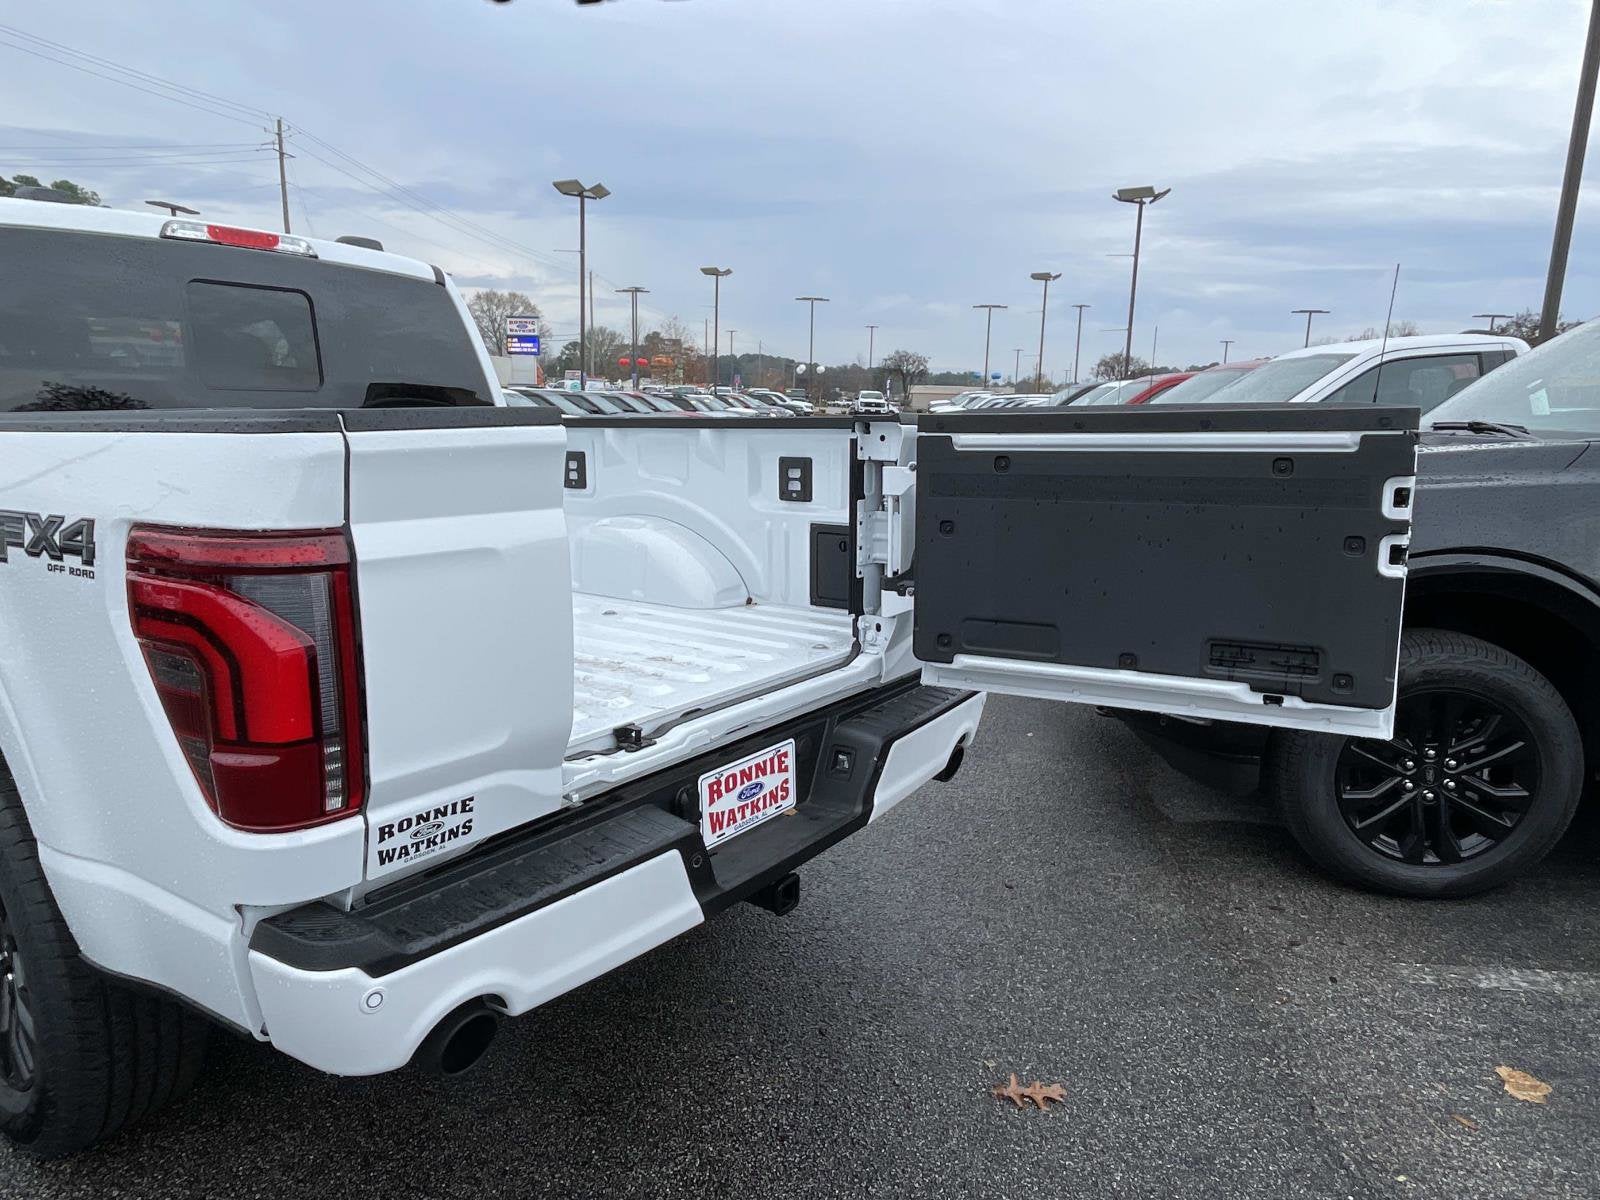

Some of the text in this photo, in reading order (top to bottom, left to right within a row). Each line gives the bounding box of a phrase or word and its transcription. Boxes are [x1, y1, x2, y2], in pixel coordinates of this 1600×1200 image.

[0, 509, 96, 567] FX4
[47, 563, 95, 580] OFF ROAD
[707, 751, 789, 807] RONNIE
[378, 796, 475, 844] RONNIE
[708, 778, 790, 835] WATKINS
[377, 818, 473, 866] WATKINS
